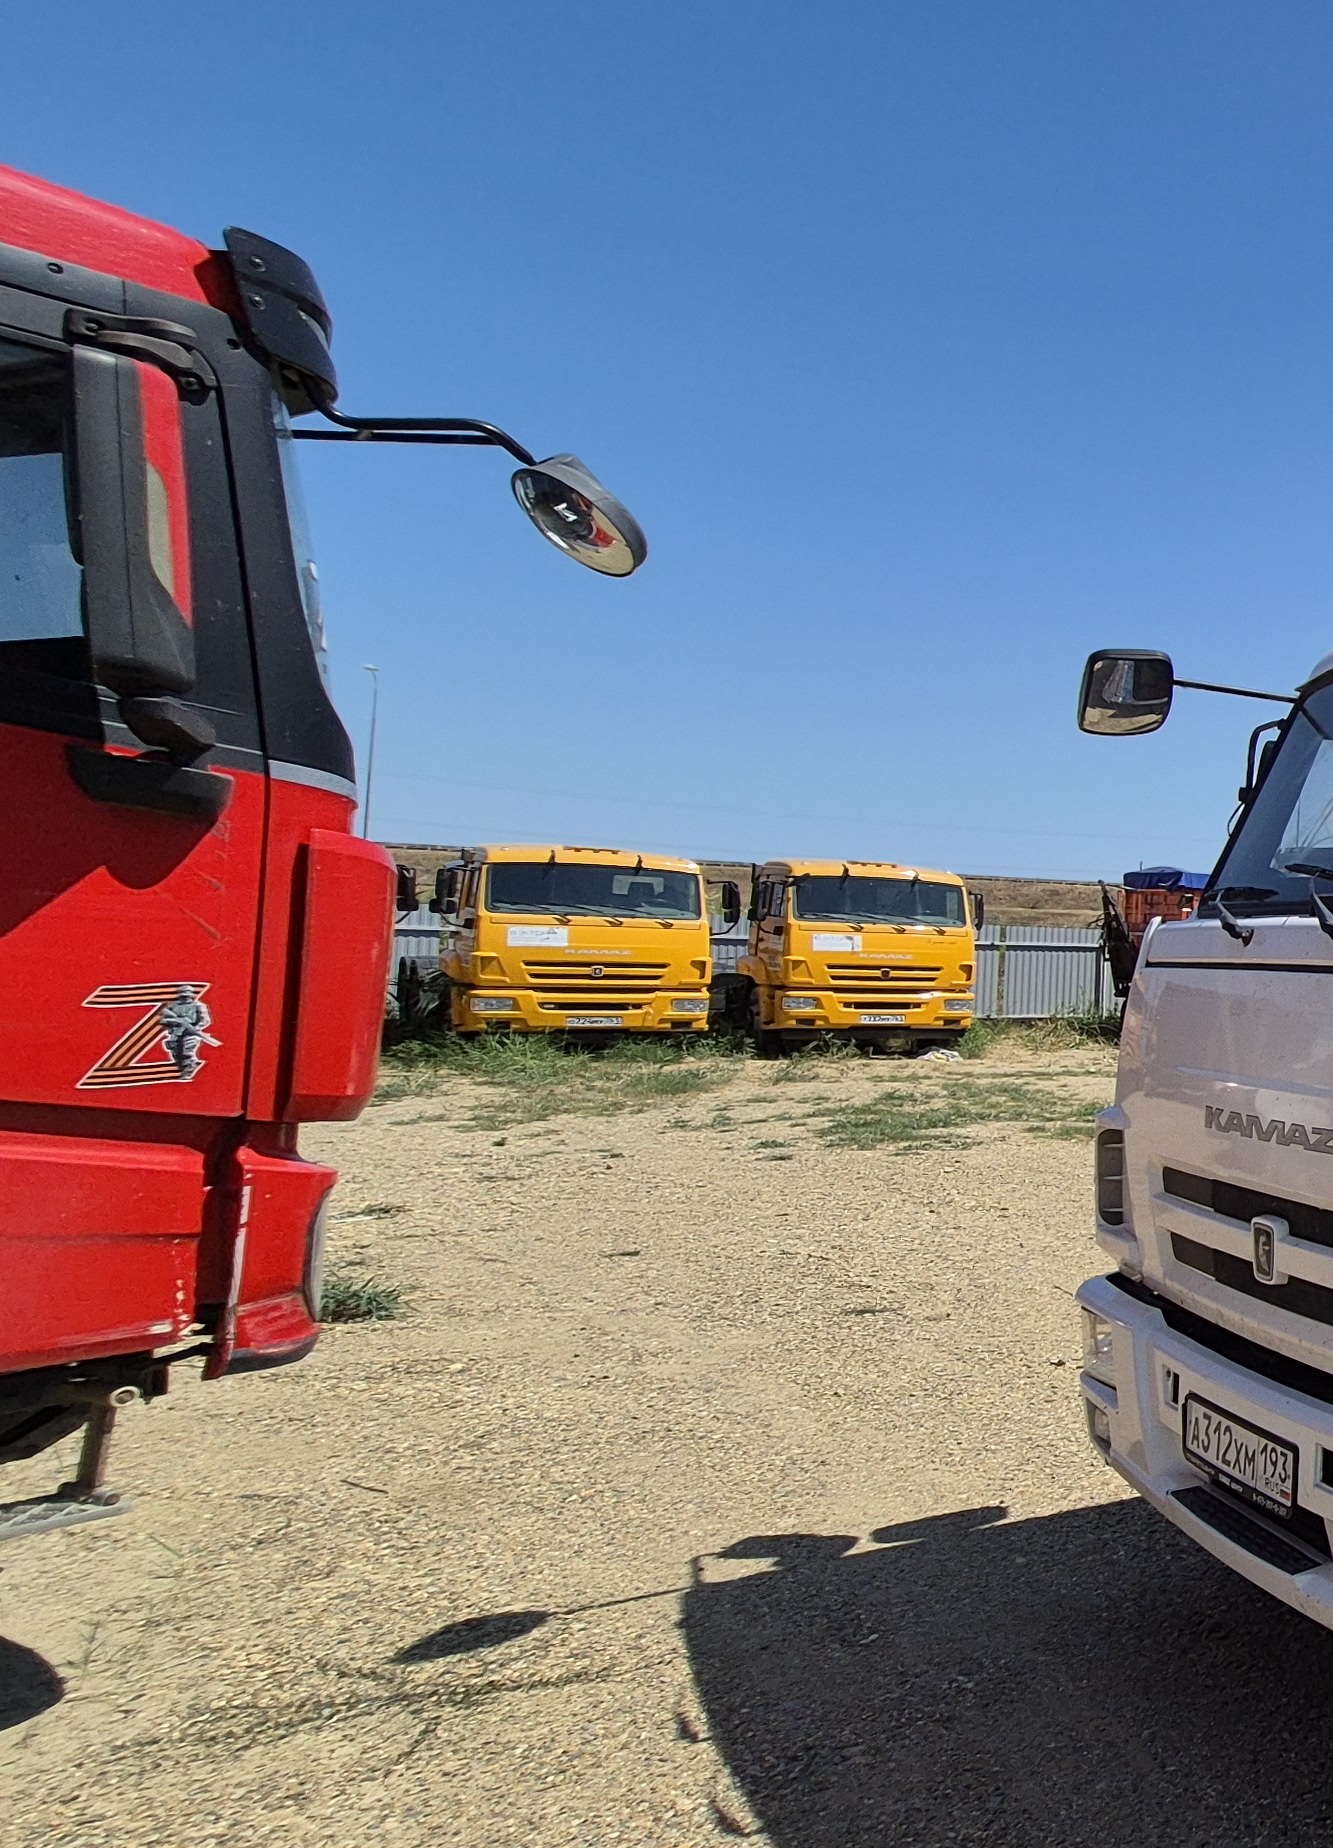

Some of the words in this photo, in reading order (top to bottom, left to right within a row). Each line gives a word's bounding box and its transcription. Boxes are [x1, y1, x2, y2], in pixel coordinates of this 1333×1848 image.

[1190, 1411, 1257, 1481] А312ХМ
[1259, 1442, 1289, 1485] 193
[1264, 1476, 1281, 1496] RUS
